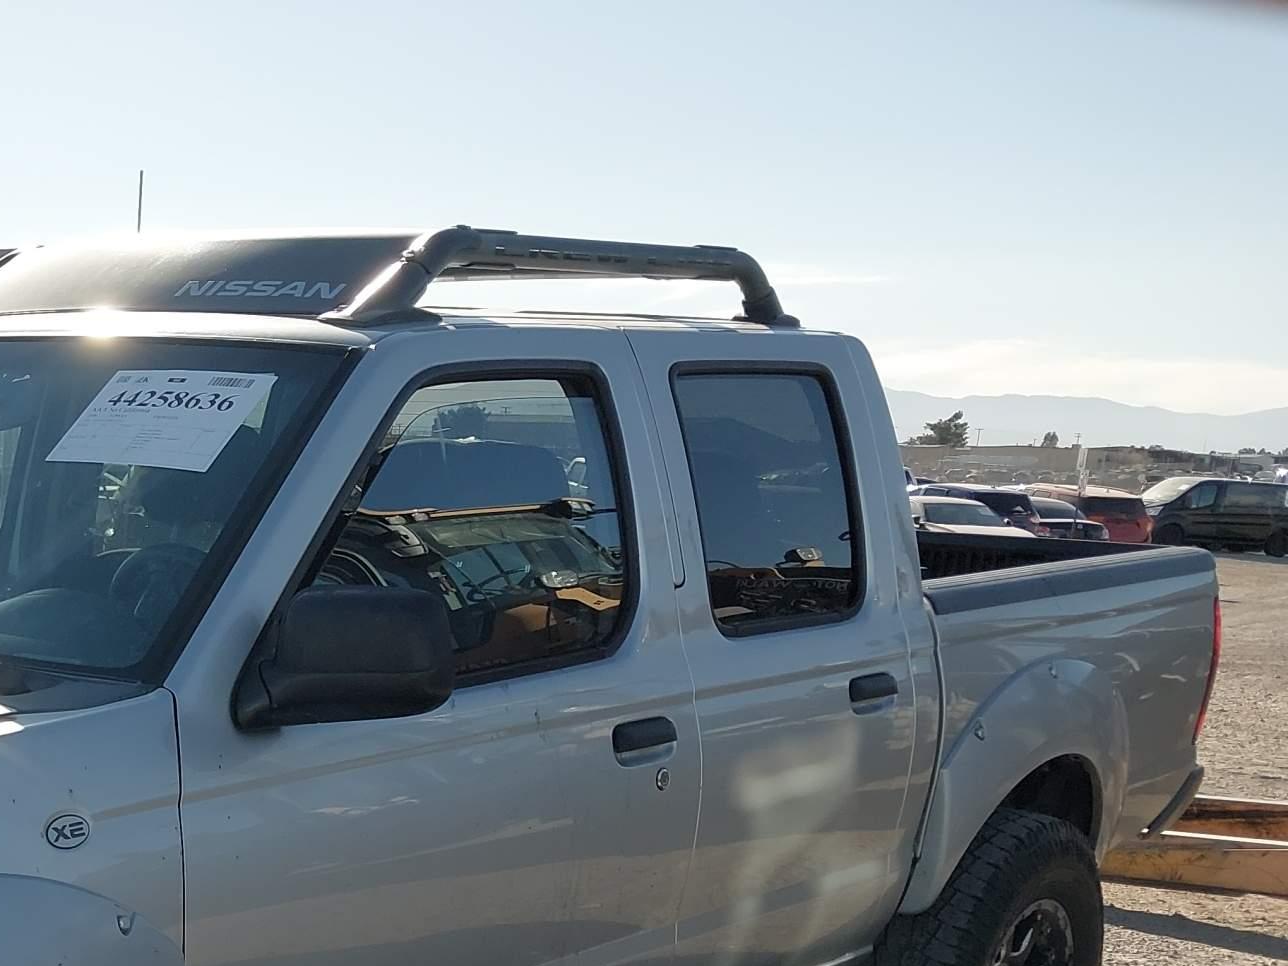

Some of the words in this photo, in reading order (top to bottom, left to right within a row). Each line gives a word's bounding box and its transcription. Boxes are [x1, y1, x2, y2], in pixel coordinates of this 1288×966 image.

[174, 280, 347, 299] NISSAN
[108, 390, 241, 412] 44258636
[51, 821, 86, 843] XE
